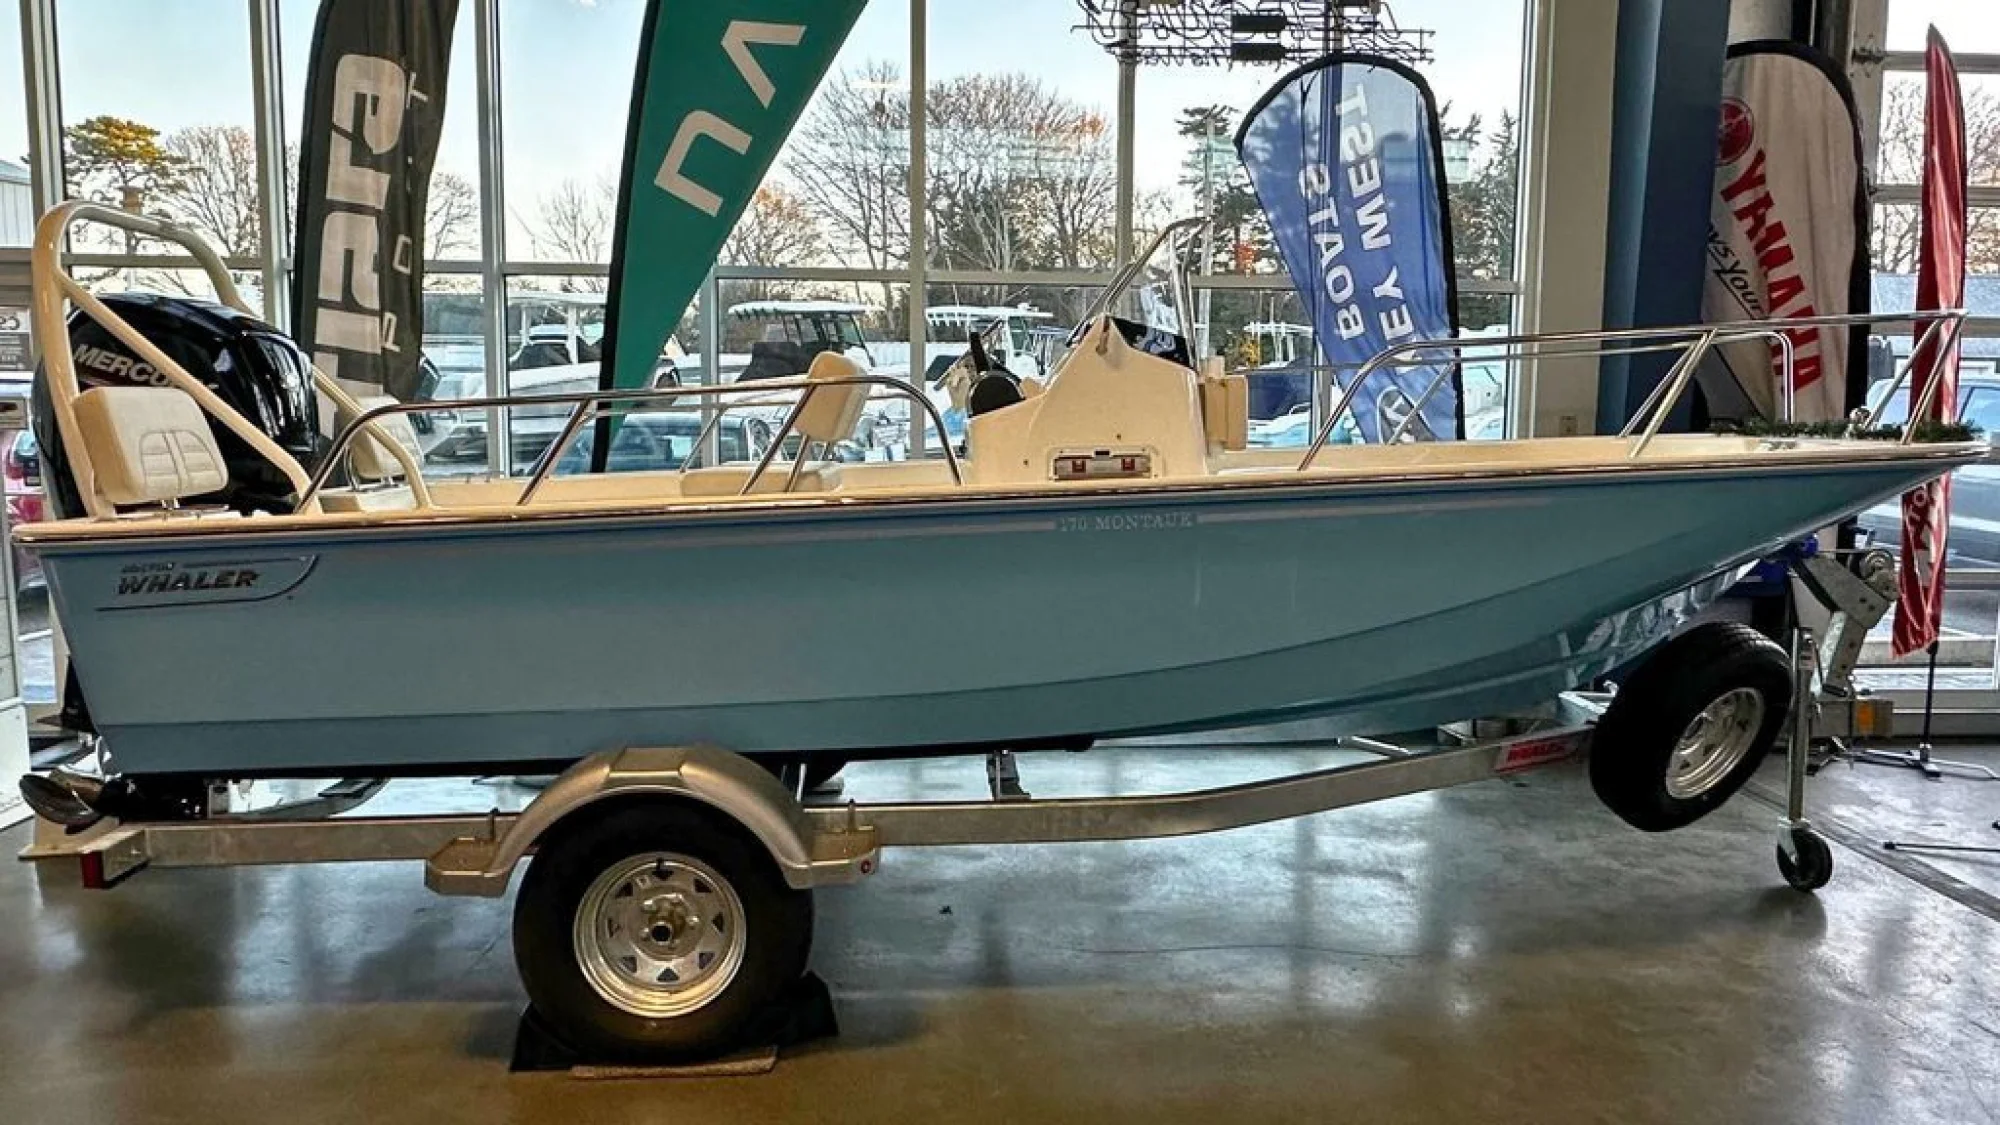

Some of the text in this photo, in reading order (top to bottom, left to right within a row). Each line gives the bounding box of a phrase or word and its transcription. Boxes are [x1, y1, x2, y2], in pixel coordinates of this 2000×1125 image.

[1719, 148, 1824, 396] YAMAHA
[73, 343, 219, 389] MERCU
[1095, 511, 1193, 531] MONTAUK
[117, 569, 260, 595] WHALER
